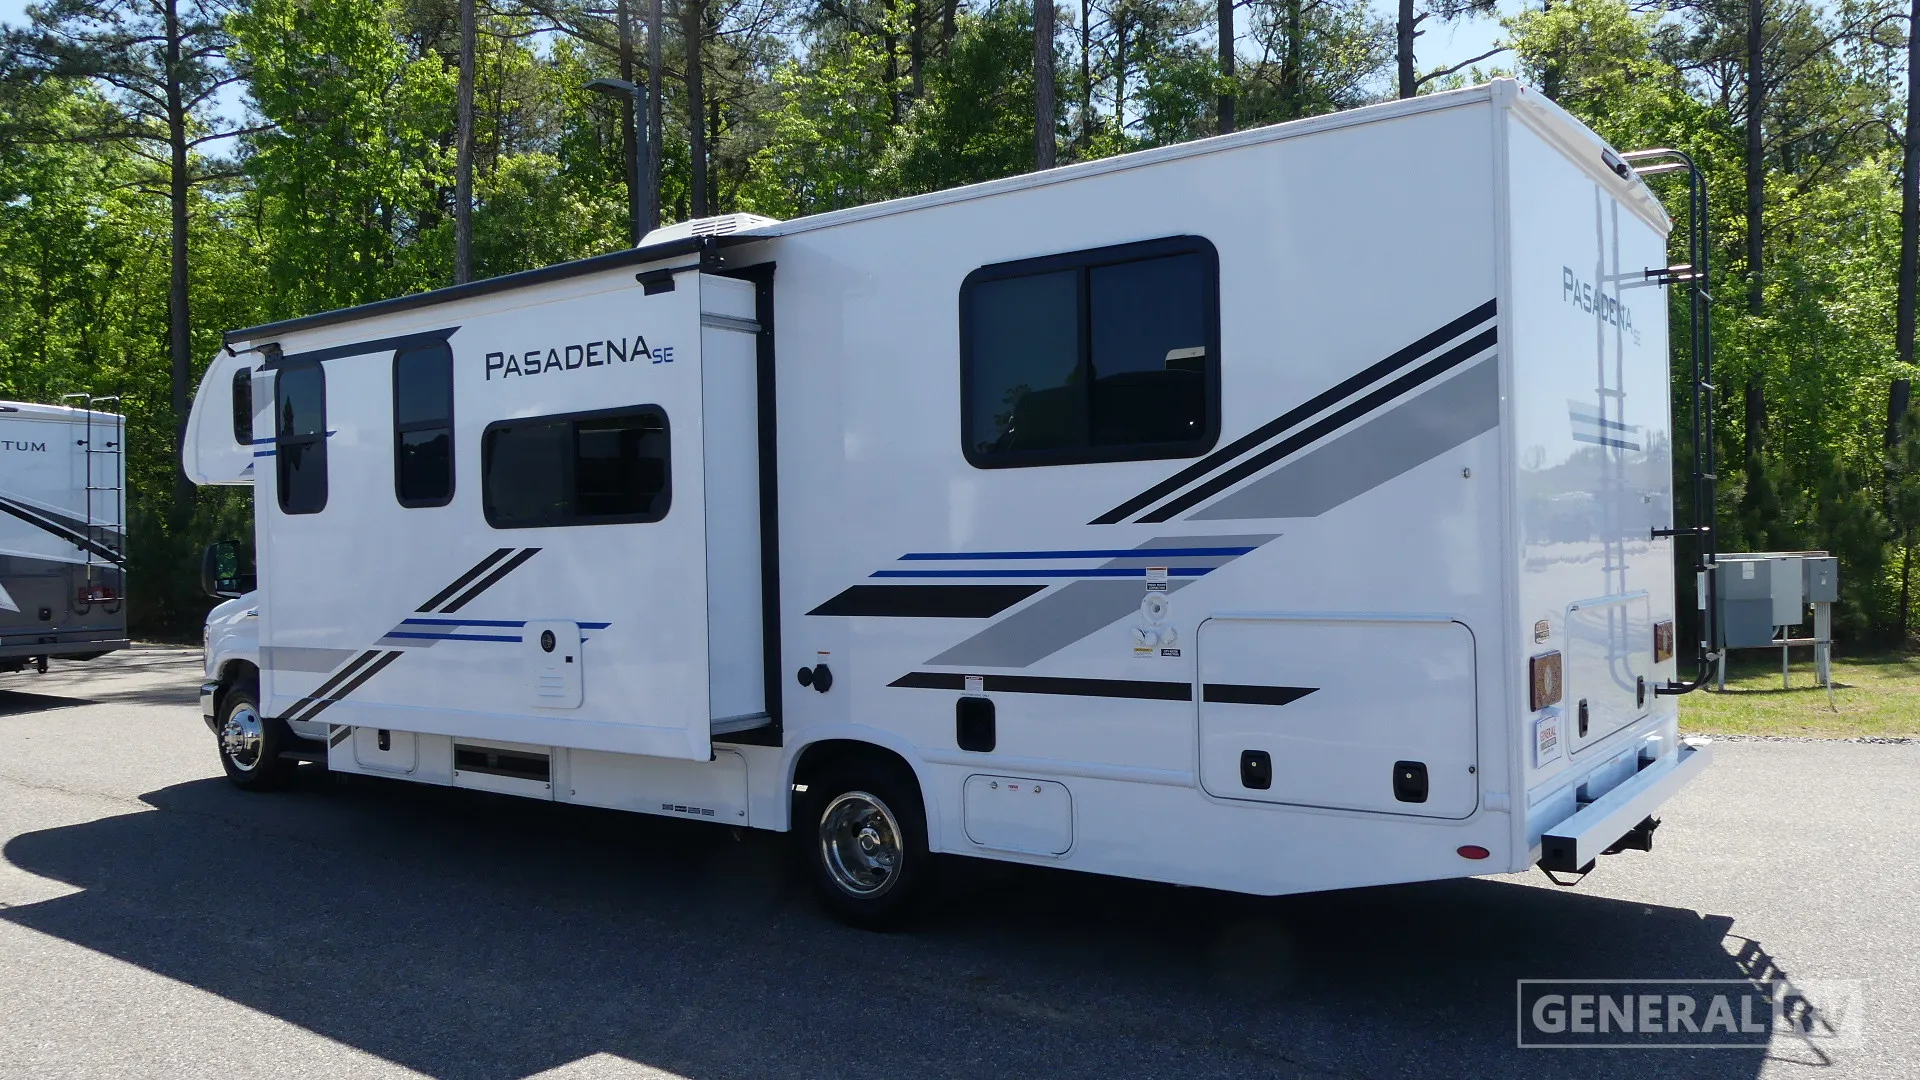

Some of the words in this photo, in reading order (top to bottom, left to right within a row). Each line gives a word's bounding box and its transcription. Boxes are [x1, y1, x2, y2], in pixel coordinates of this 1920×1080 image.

[1562, 265, 1633, 334] PASADENA
[485, 335, 652, 381] PASADENA
[652, 346, 674, 364] SE
[1, 440, 47, 452] TUM
